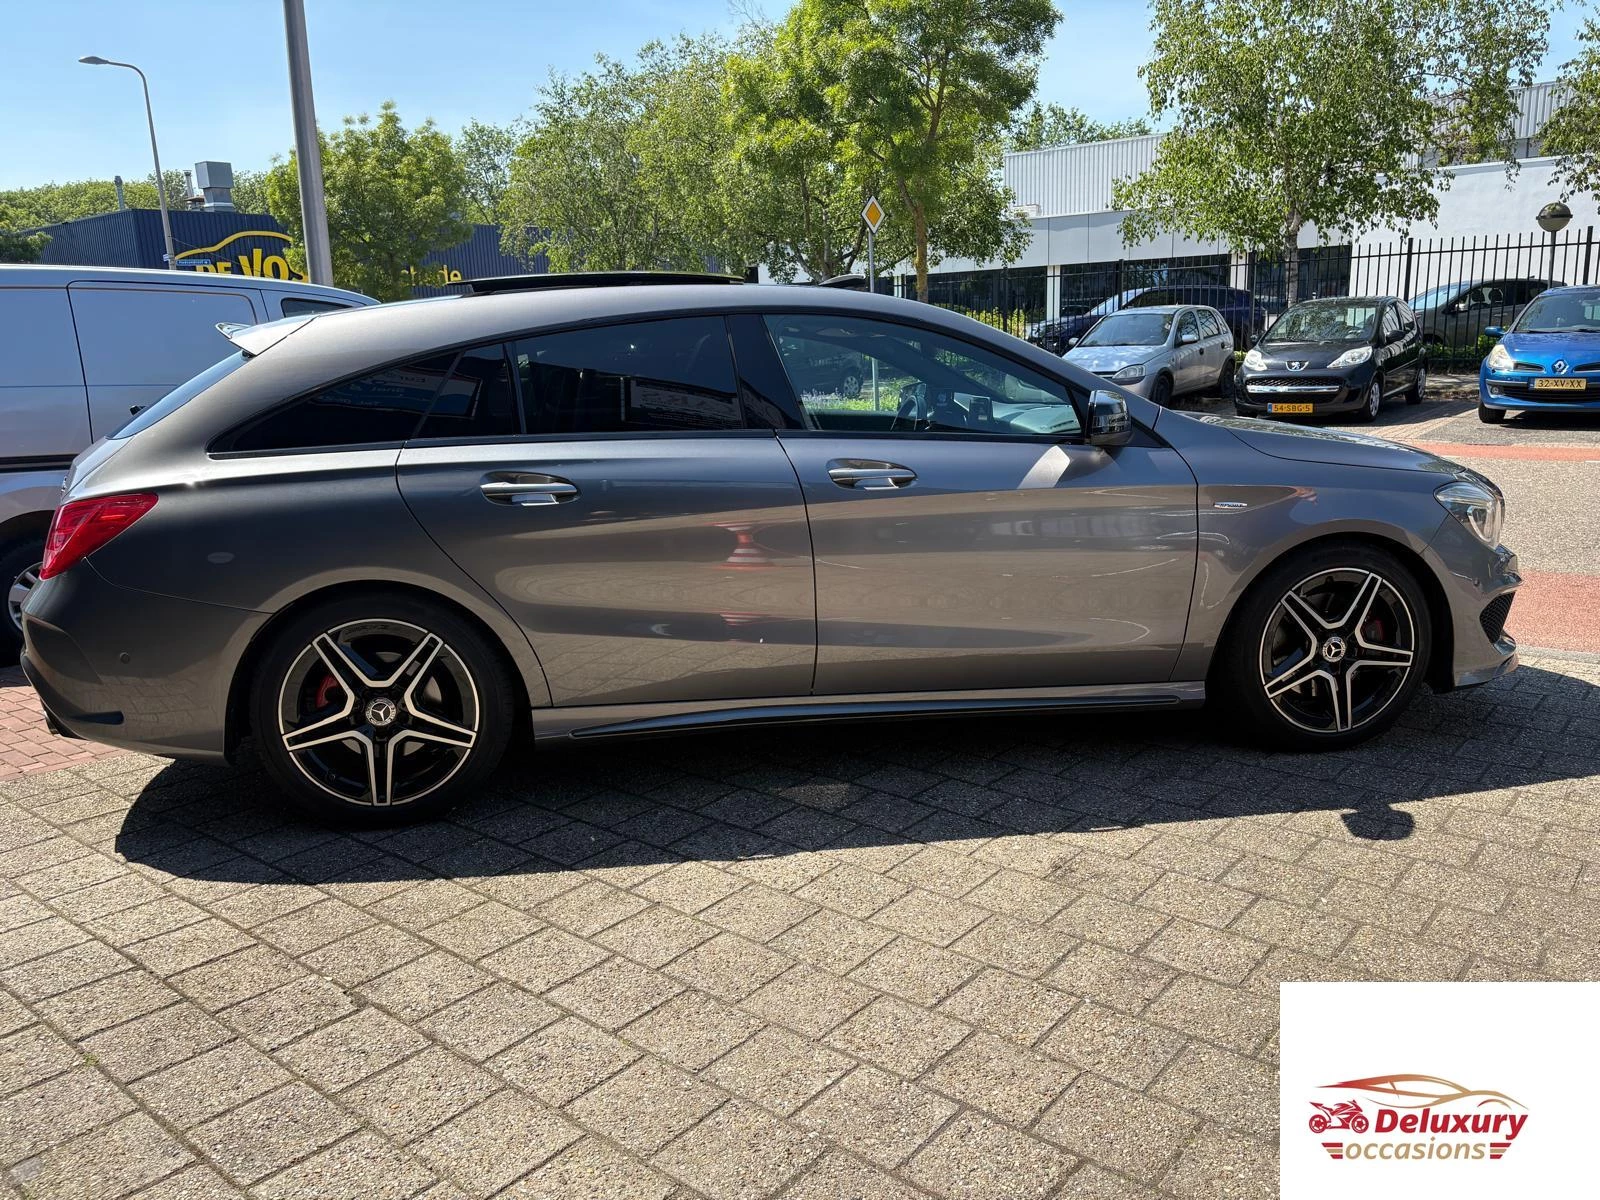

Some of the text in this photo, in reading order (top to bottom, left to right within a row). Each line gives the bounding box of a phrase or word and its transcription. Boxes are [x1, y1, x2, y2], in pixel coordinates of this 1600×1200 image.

[238, 249, 309, 283] VO
[1538, 379, 1582, 388] 32-XV-XX
[1273, 404, 1311, 412] 54-SBG-5
